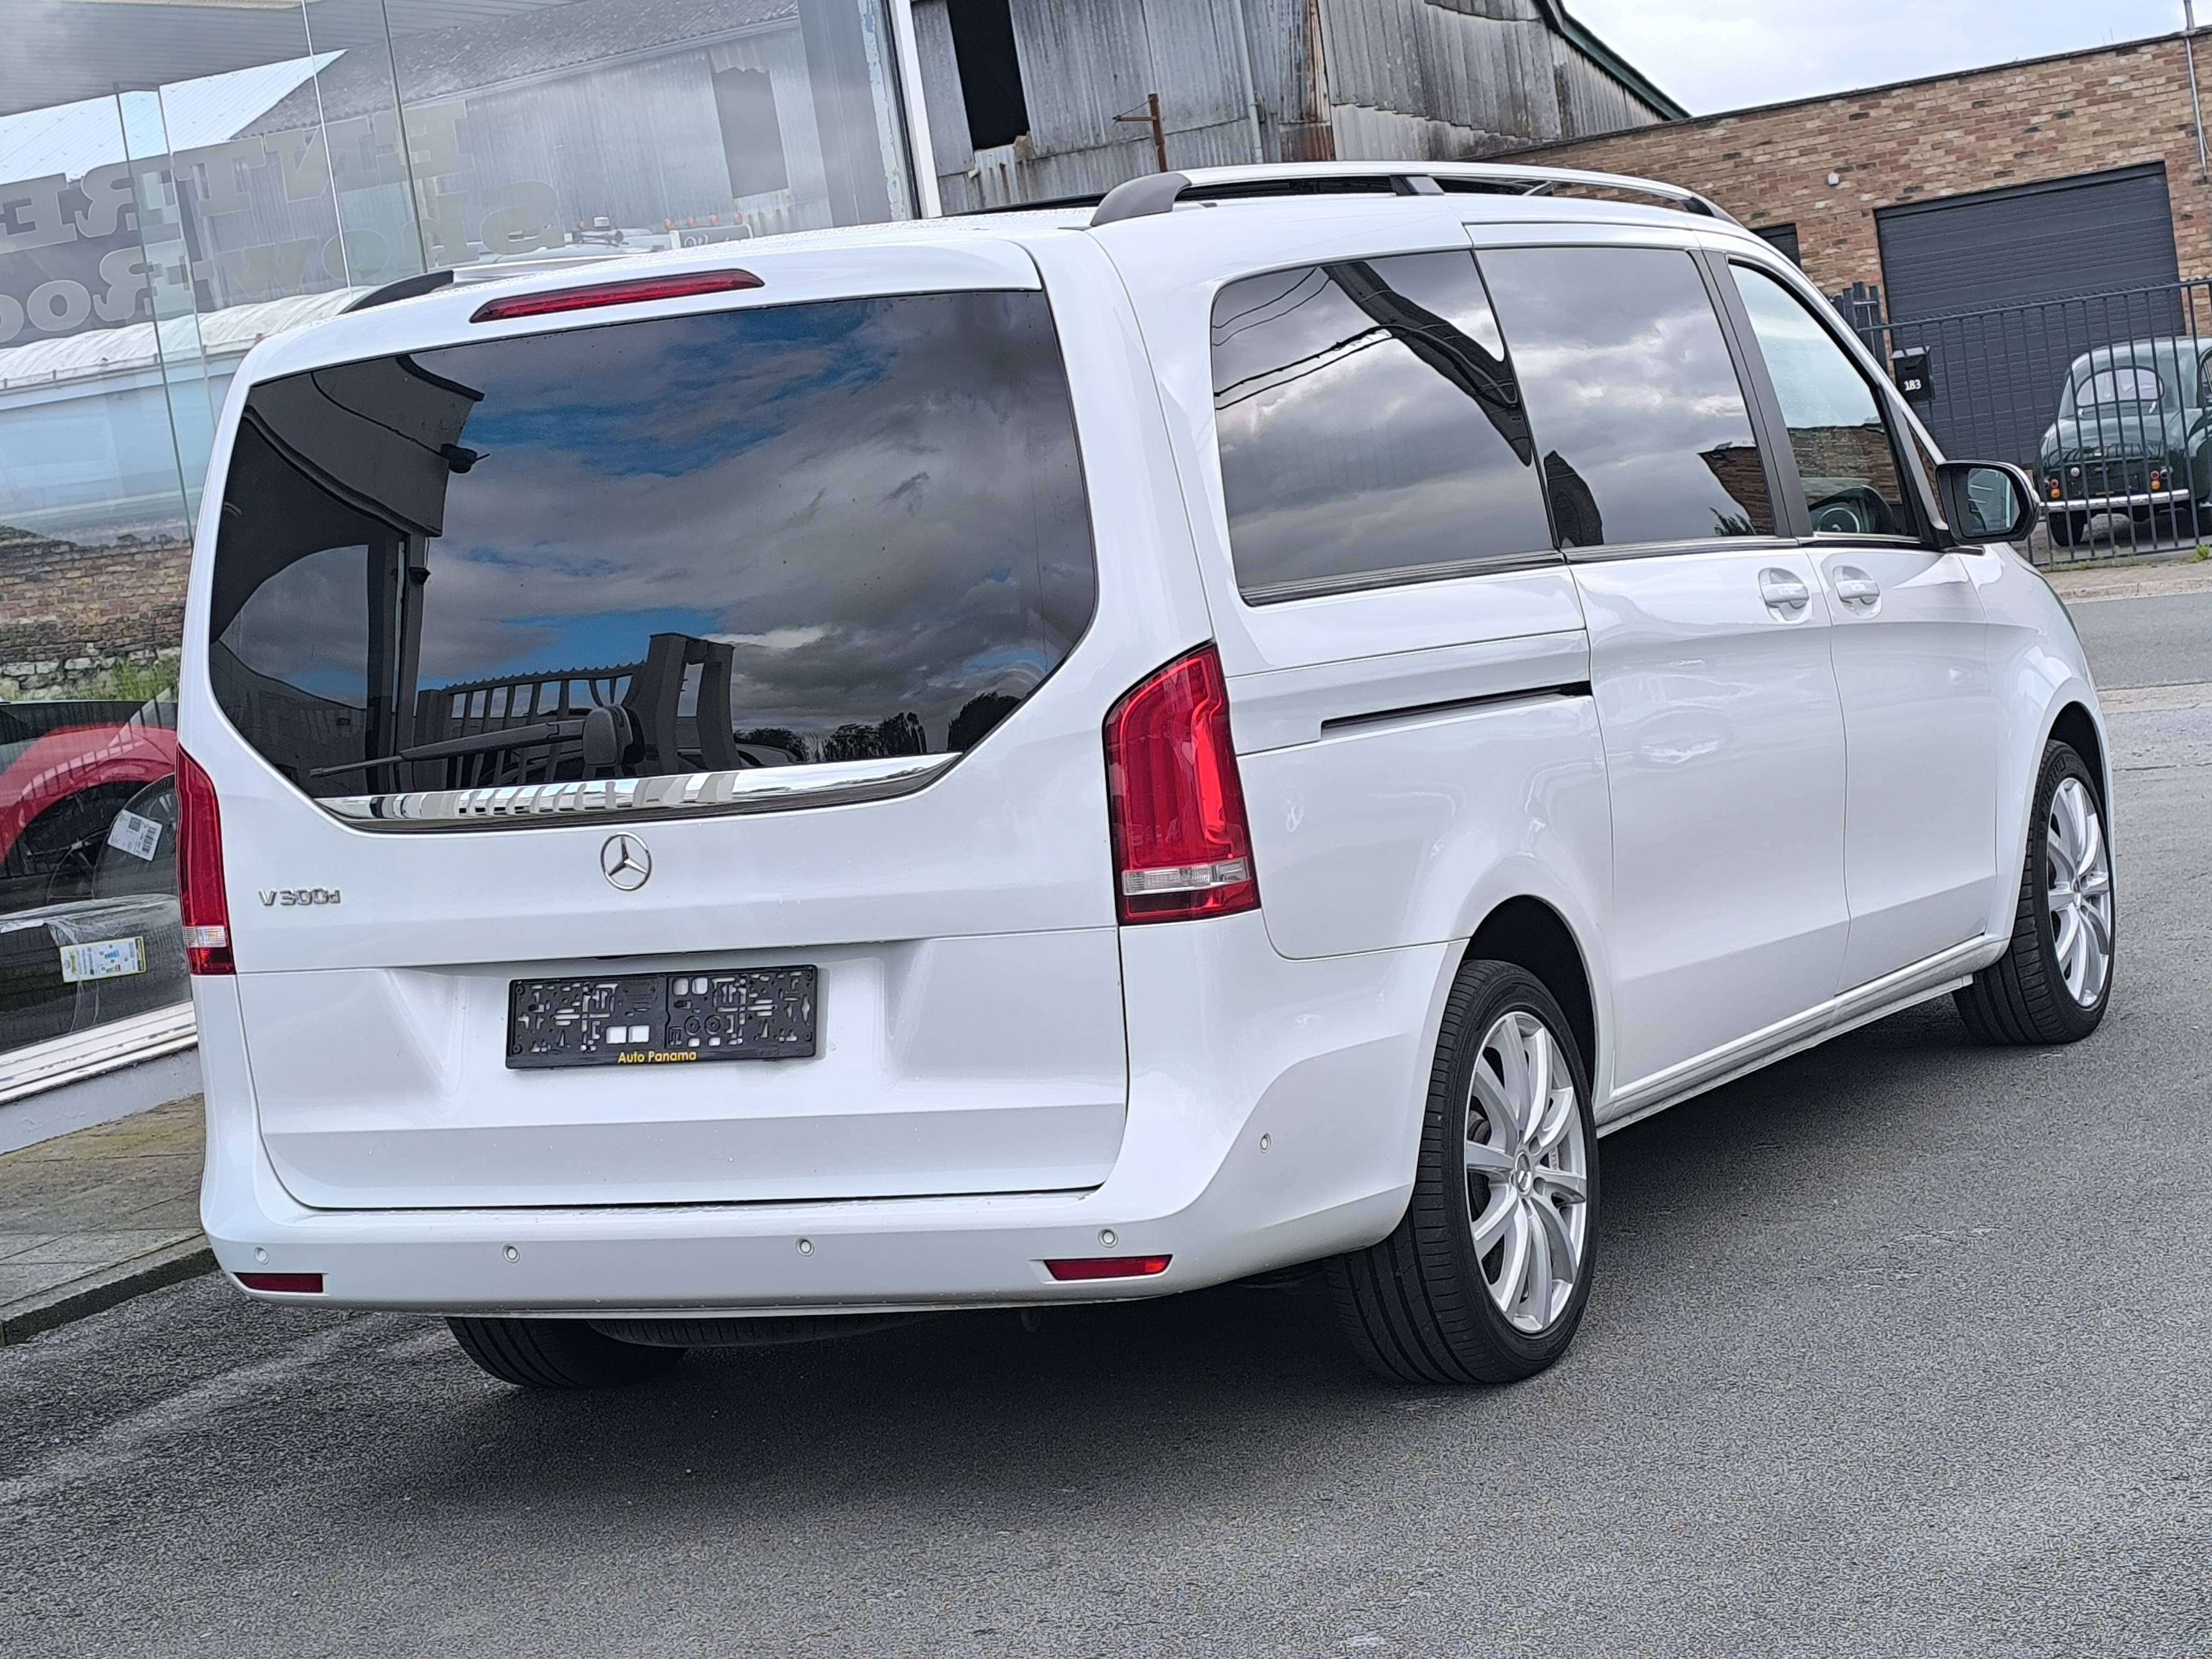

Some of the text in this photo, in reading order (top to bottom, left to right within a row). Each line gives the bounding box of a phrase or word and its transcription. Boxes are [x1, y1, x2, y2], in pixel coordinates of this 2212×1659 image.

[1904, 379, 1921, 391] 183
[618, 1050, 697, 1064] Auto Panama
